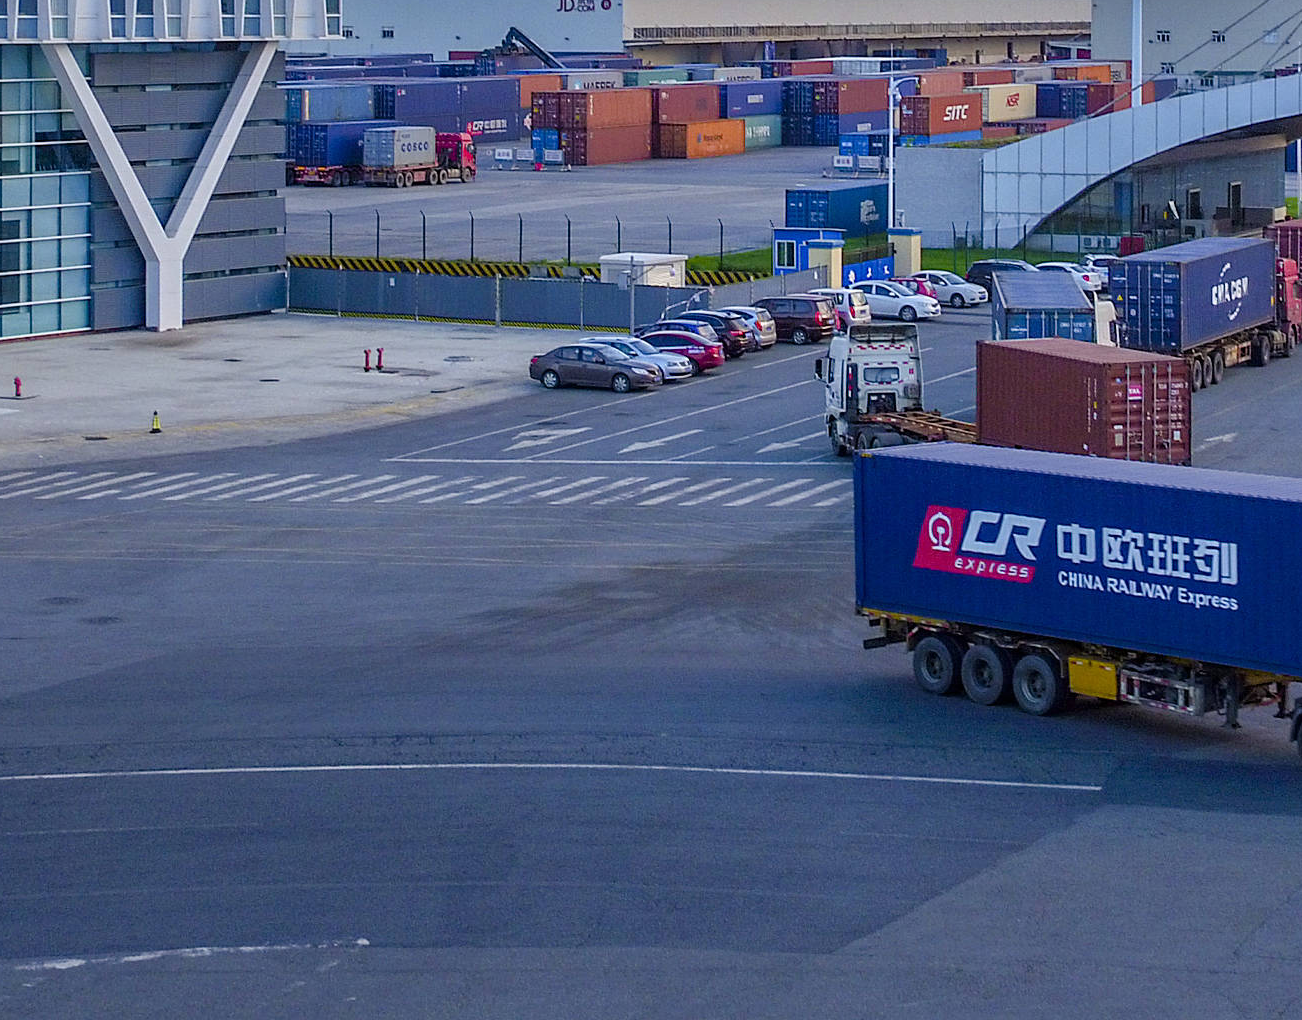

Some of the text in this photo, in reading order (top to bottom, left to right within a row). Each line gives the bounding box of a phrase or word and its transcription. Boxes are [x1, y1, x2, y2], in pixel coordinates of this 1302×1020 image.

[943, 105, 969, 121] SITC
[401, 141, 429, 152] COSCO
[961, 510, 1047, 561] CR
[954, 557, 1030, 578] express
[1056, 523, 1239, 585] 中欧班列
[1058, 570, 1239, 611] CHINA RAILWAY Express
